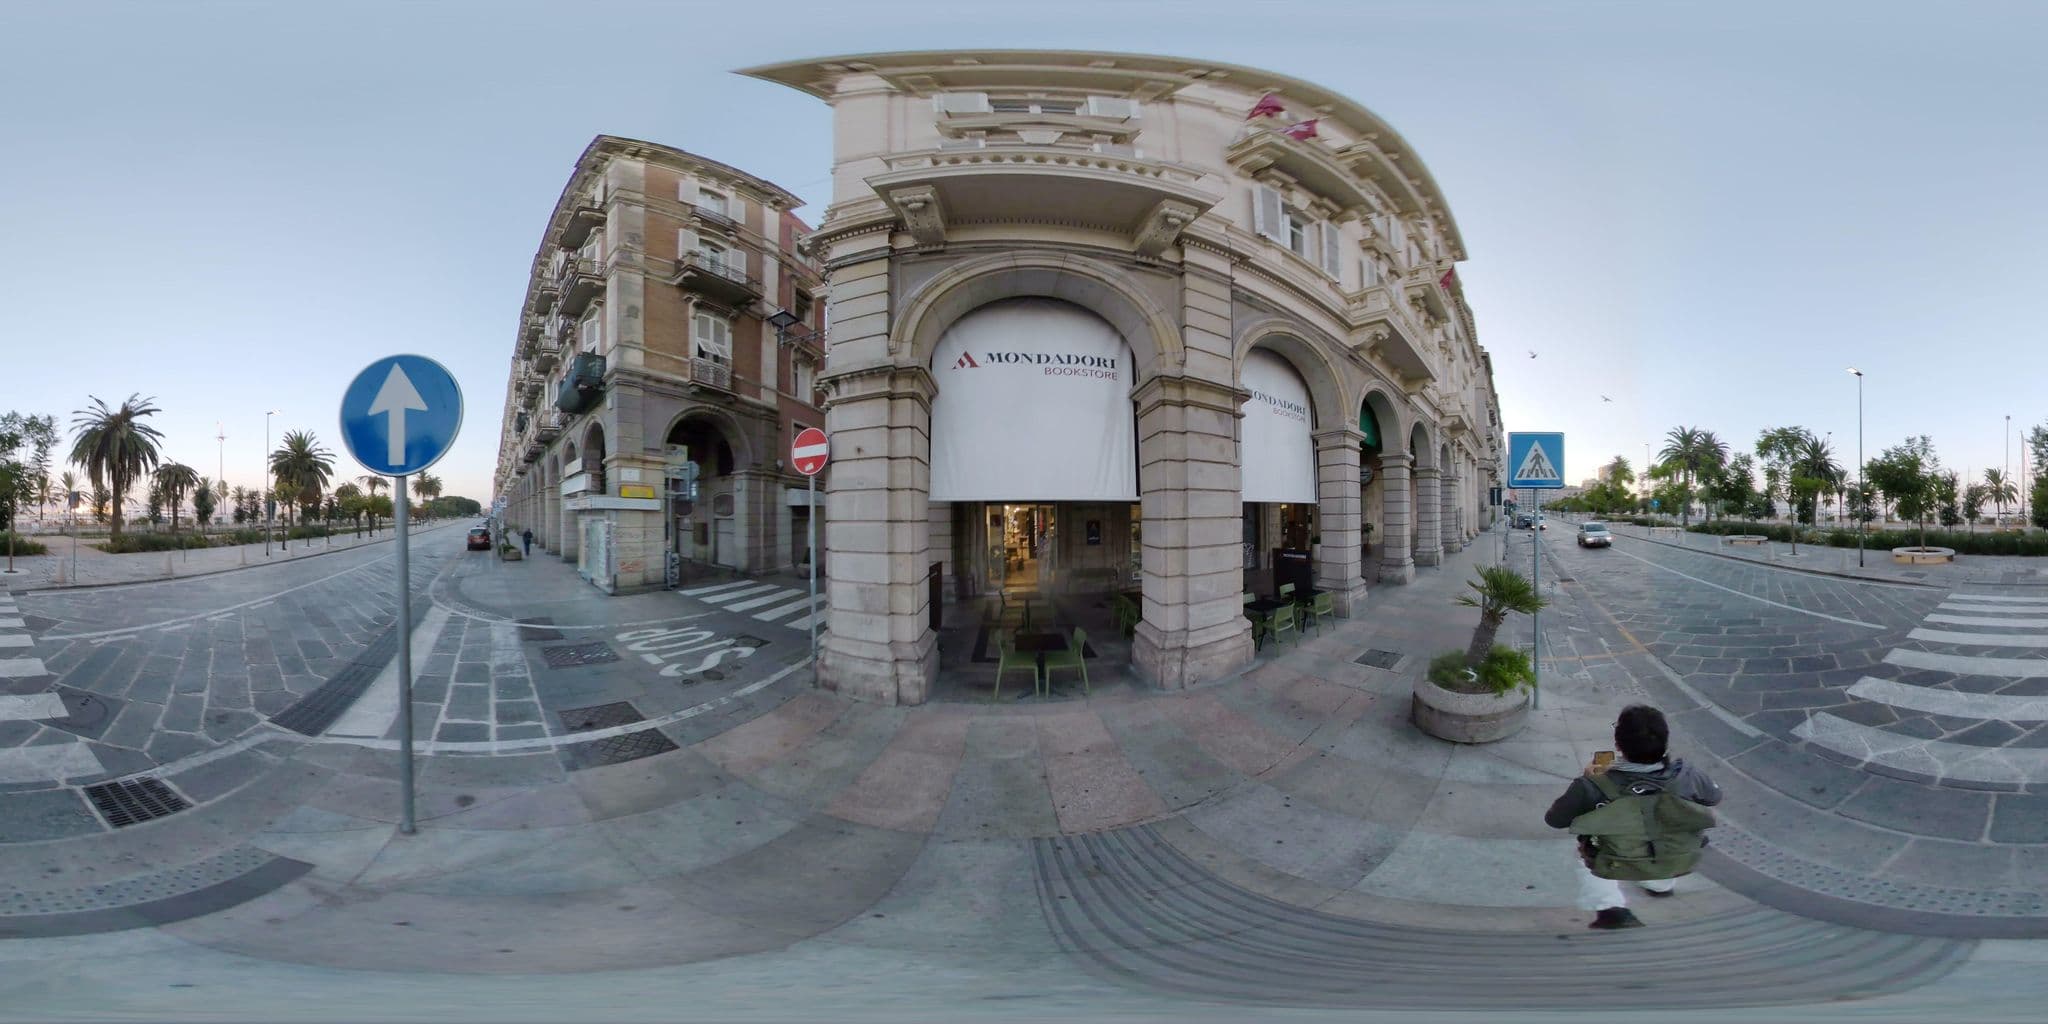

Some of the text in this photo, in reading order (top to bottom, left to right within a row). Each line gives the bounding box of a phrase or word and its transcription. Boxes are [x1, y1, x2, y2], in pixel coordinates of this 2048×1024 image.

[985, 352, 1117, 369] MONDADORI
[1044, 367, 1118, 381] BOOKSTORE
[1253, 390, 1306, 416] ONDADORI
[615, 626, 756, 677] STOP
